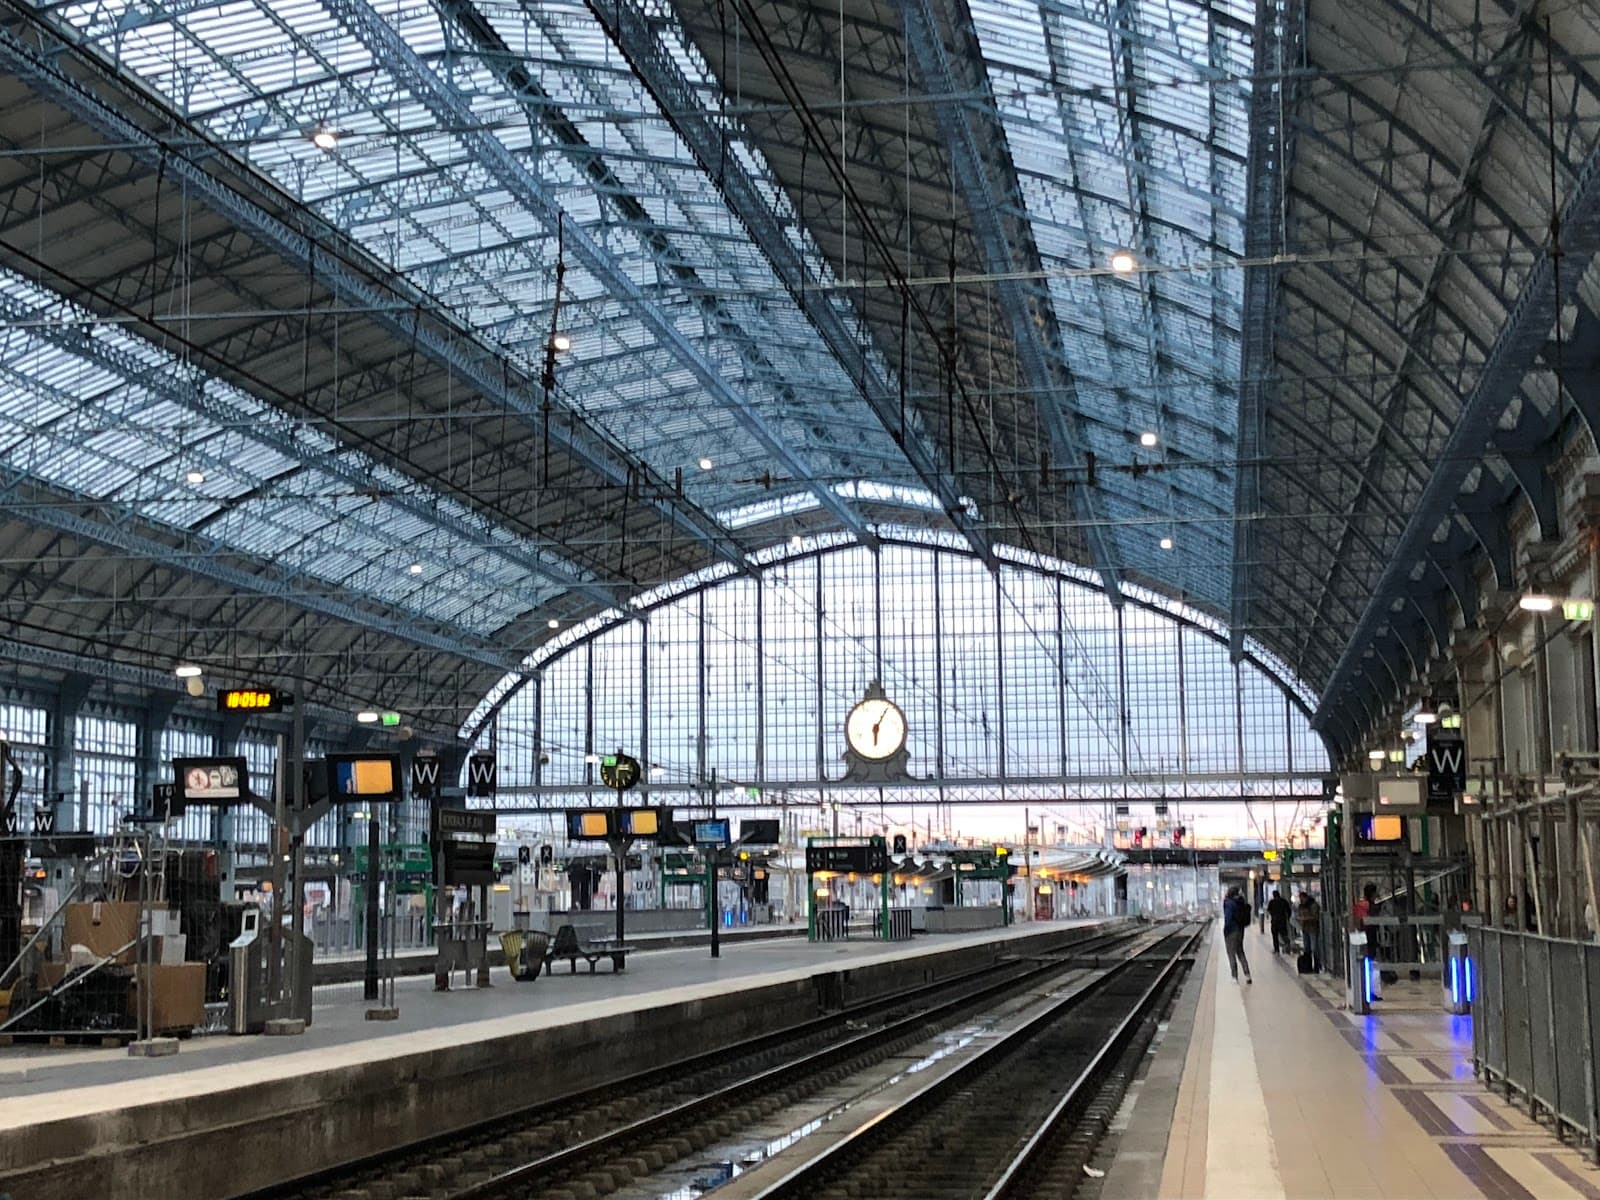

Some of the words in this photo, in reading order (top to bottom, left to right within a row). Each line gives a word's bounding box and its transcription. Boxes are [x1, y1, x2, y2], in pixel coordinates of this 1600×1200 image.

[1432, 748, 1462, 774] W
[415, 763, 439, 784] W
[472, 763, 494, 783] W
[36, 815, 53, 831] W
